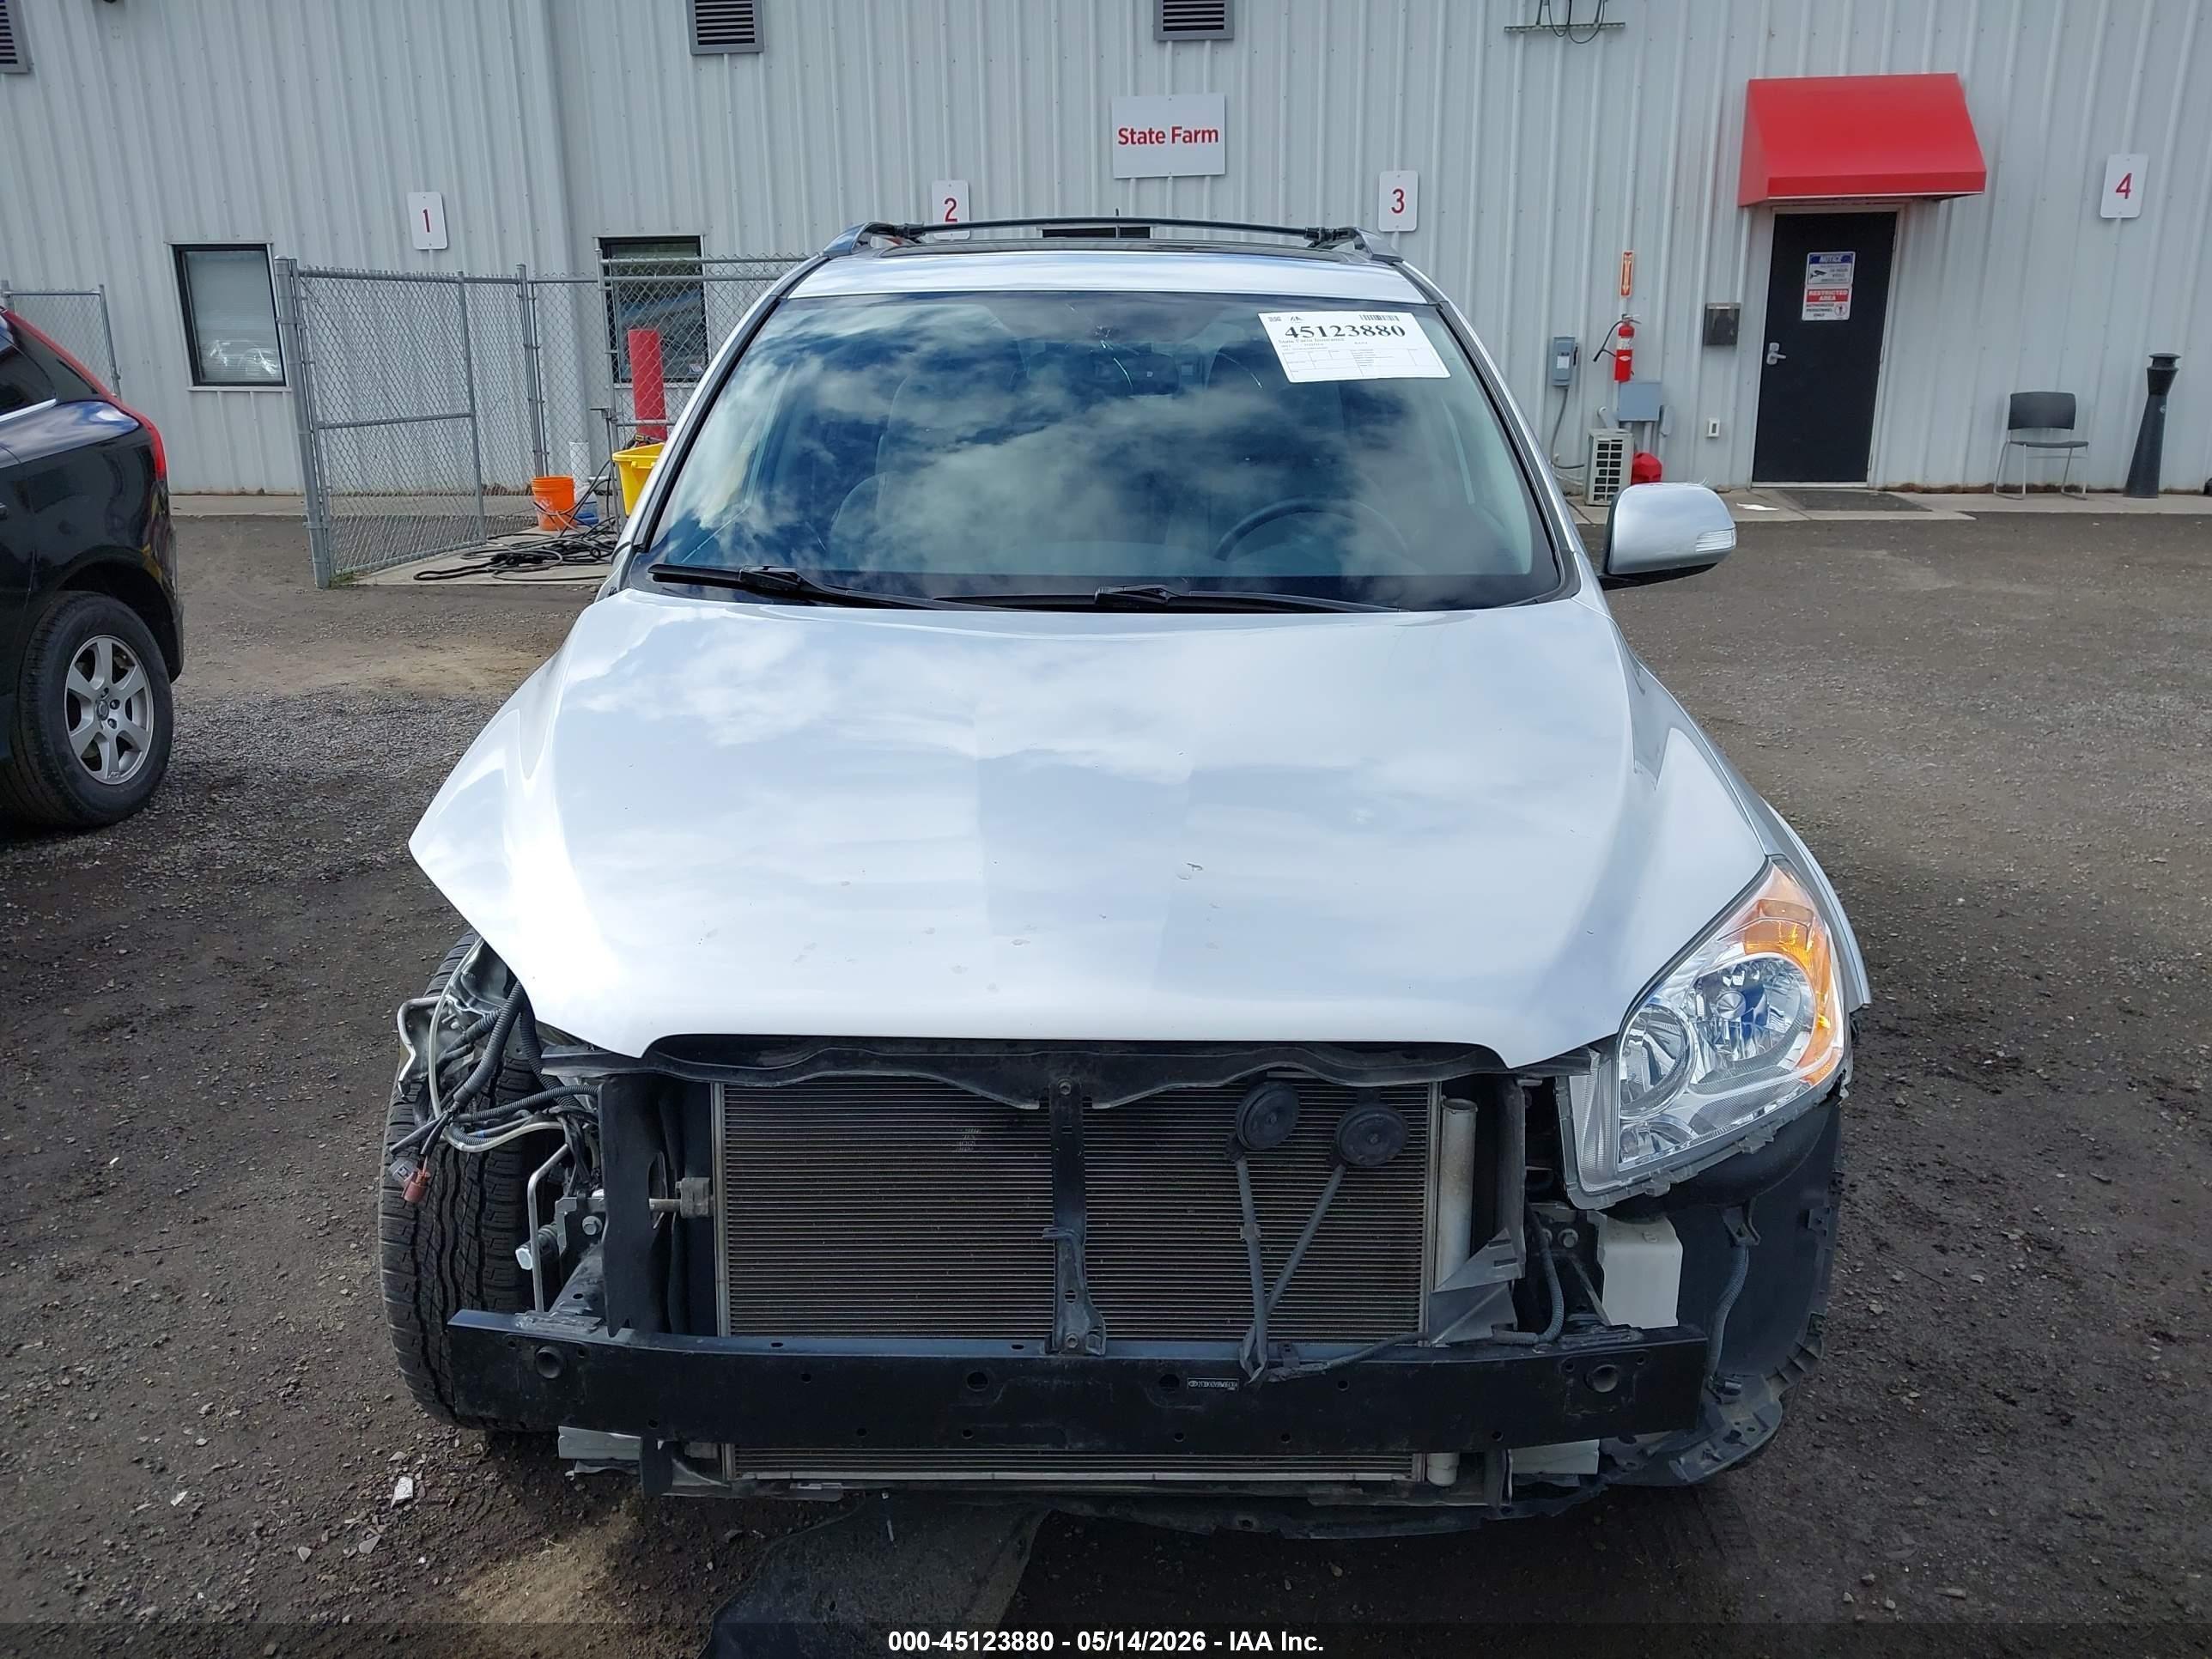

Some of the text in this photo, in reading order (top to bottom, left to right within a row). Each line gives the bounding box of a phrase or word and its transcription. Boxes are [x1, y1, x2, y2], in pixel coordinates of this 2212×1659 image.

[1117, 125, 1219, 145] State Farm
[2115, 172, 2132, 199] 4
[944, 198, 958, 222] 2
[1391, 188, 1405, 214] 3
[422, 209, 430, 233] 1
[1285, 325, 1406, 338] 45123880
